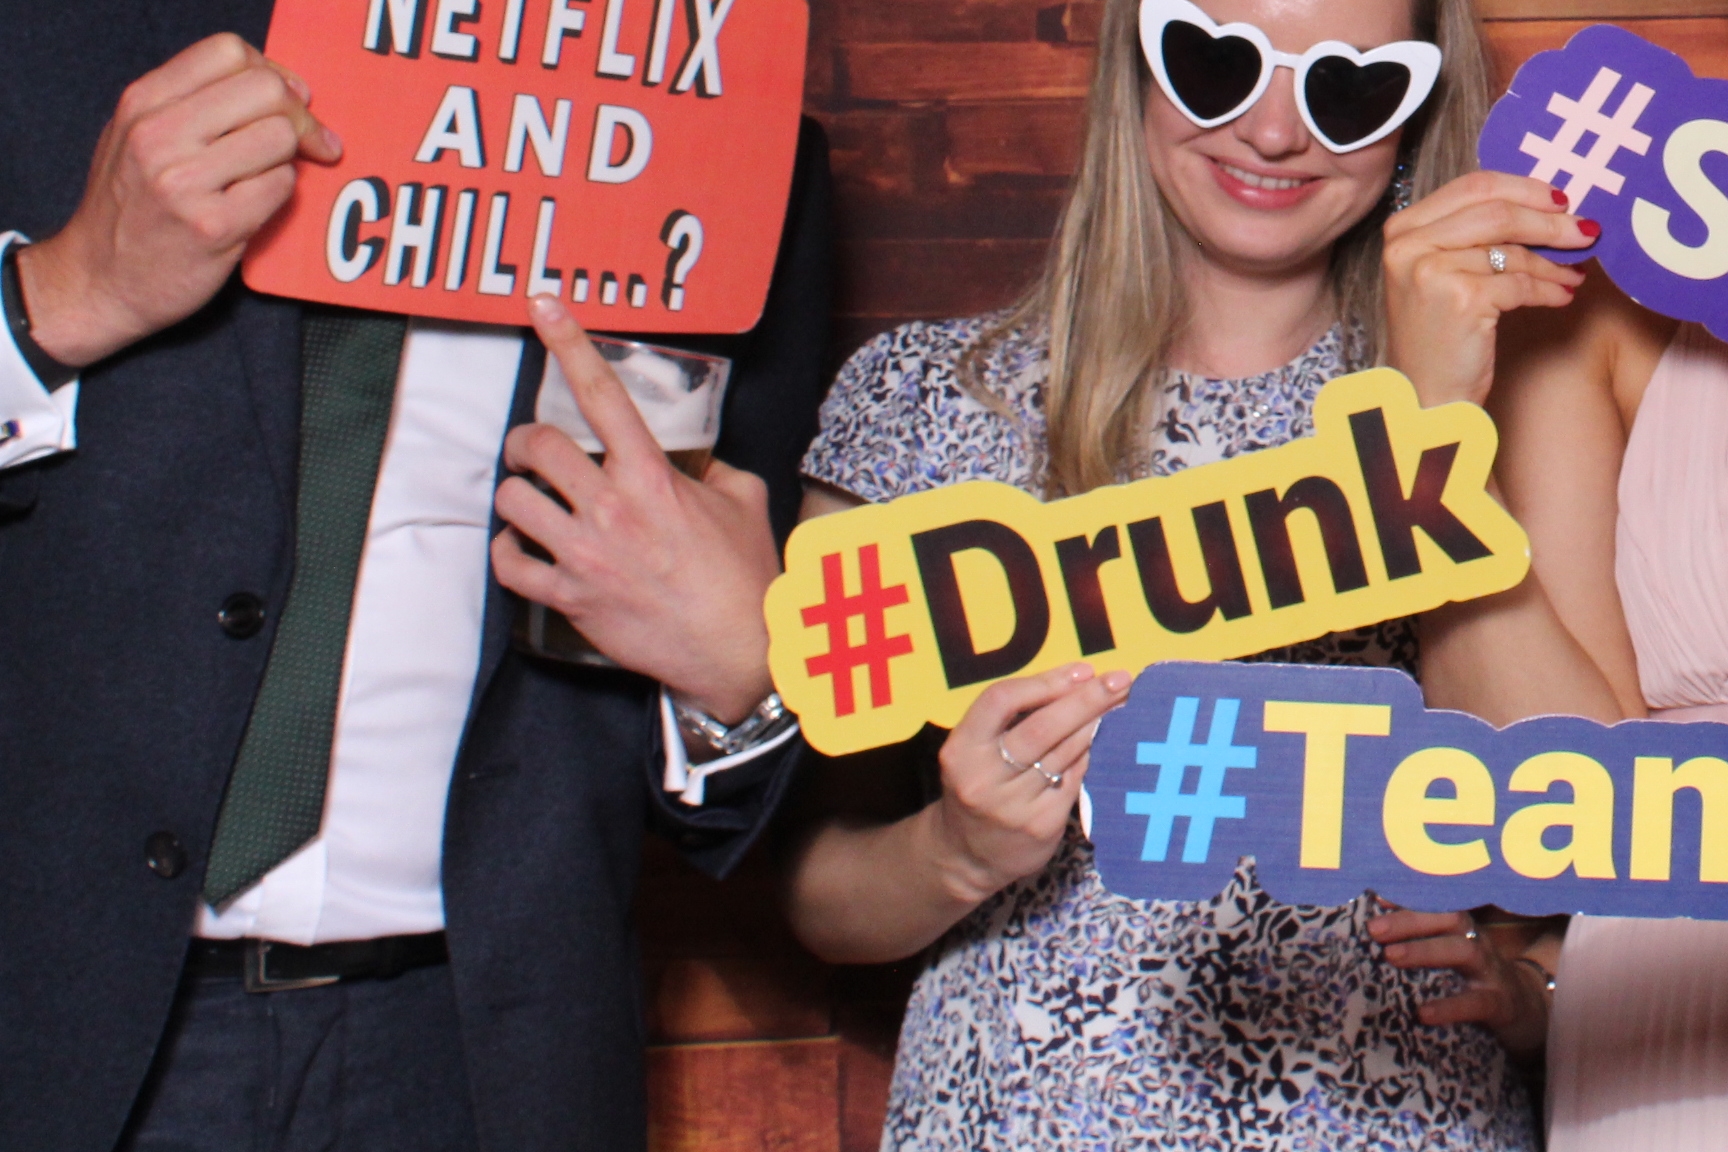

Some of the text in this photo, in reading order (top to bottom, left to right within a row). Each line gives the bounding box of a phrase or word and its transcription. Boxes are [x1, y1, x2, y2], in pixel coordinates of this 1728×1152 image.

[414, 85, 653, 184] AND
[325, 178, 704, 311] CHILL...?
[801, 407, 1492, 718] #Drunk
